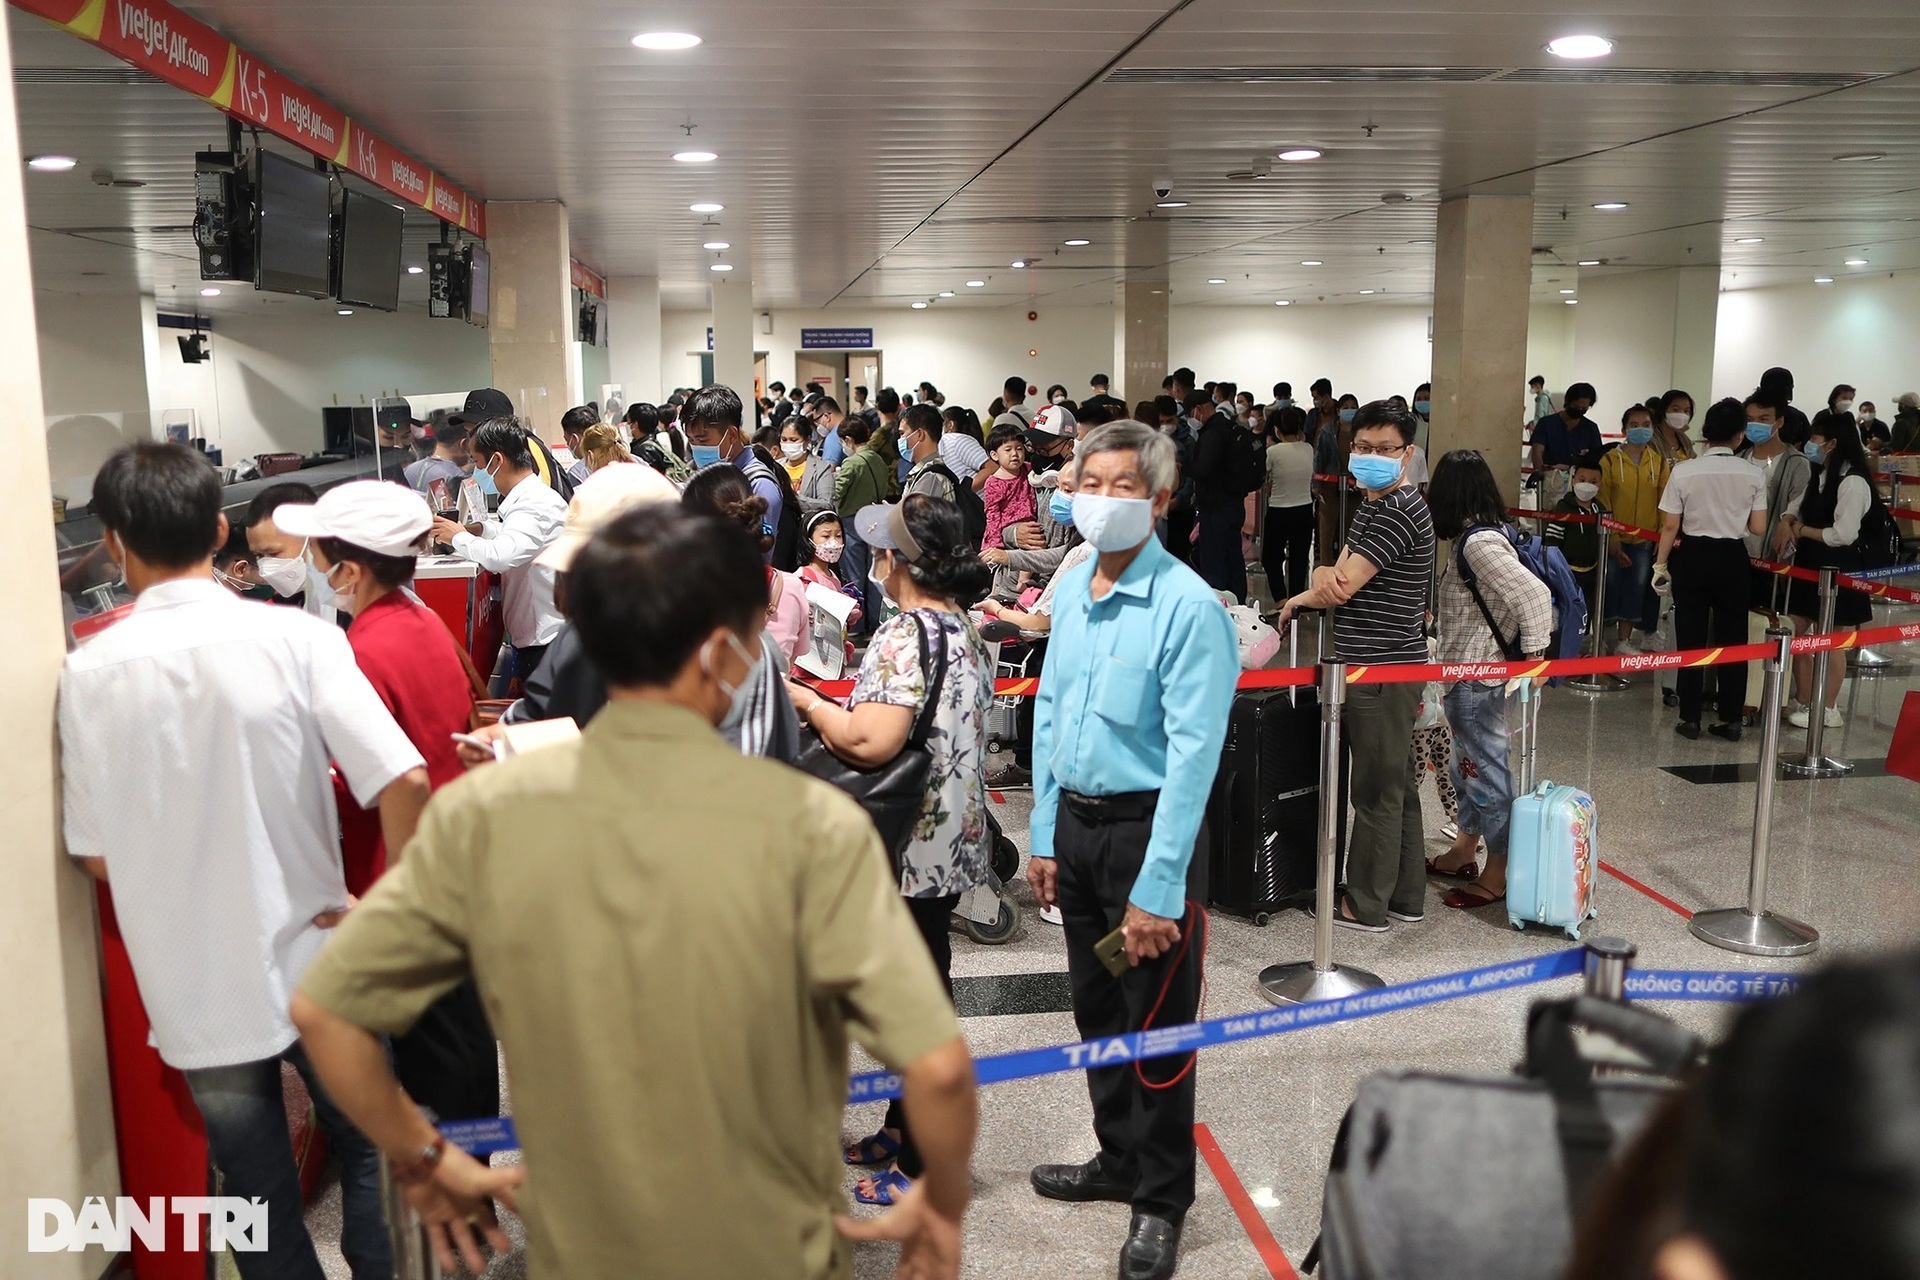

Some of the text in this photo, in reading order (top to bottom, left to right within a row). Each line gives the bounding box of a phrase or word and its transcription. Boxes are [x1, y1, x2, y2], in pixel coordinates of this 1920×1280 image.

[238, 54, 269, 123] K-5
[357, 128, 377, 180] K-6
[1222, 963, 1537, 1036] TAN SON NHAT INTERNATIONAL AIRPORT
[1687, 974, 1738, 993] QUỐC
[1743, 974, 1767, 995] TẾ
[1062, 1038, 1131, 1066] TIA
